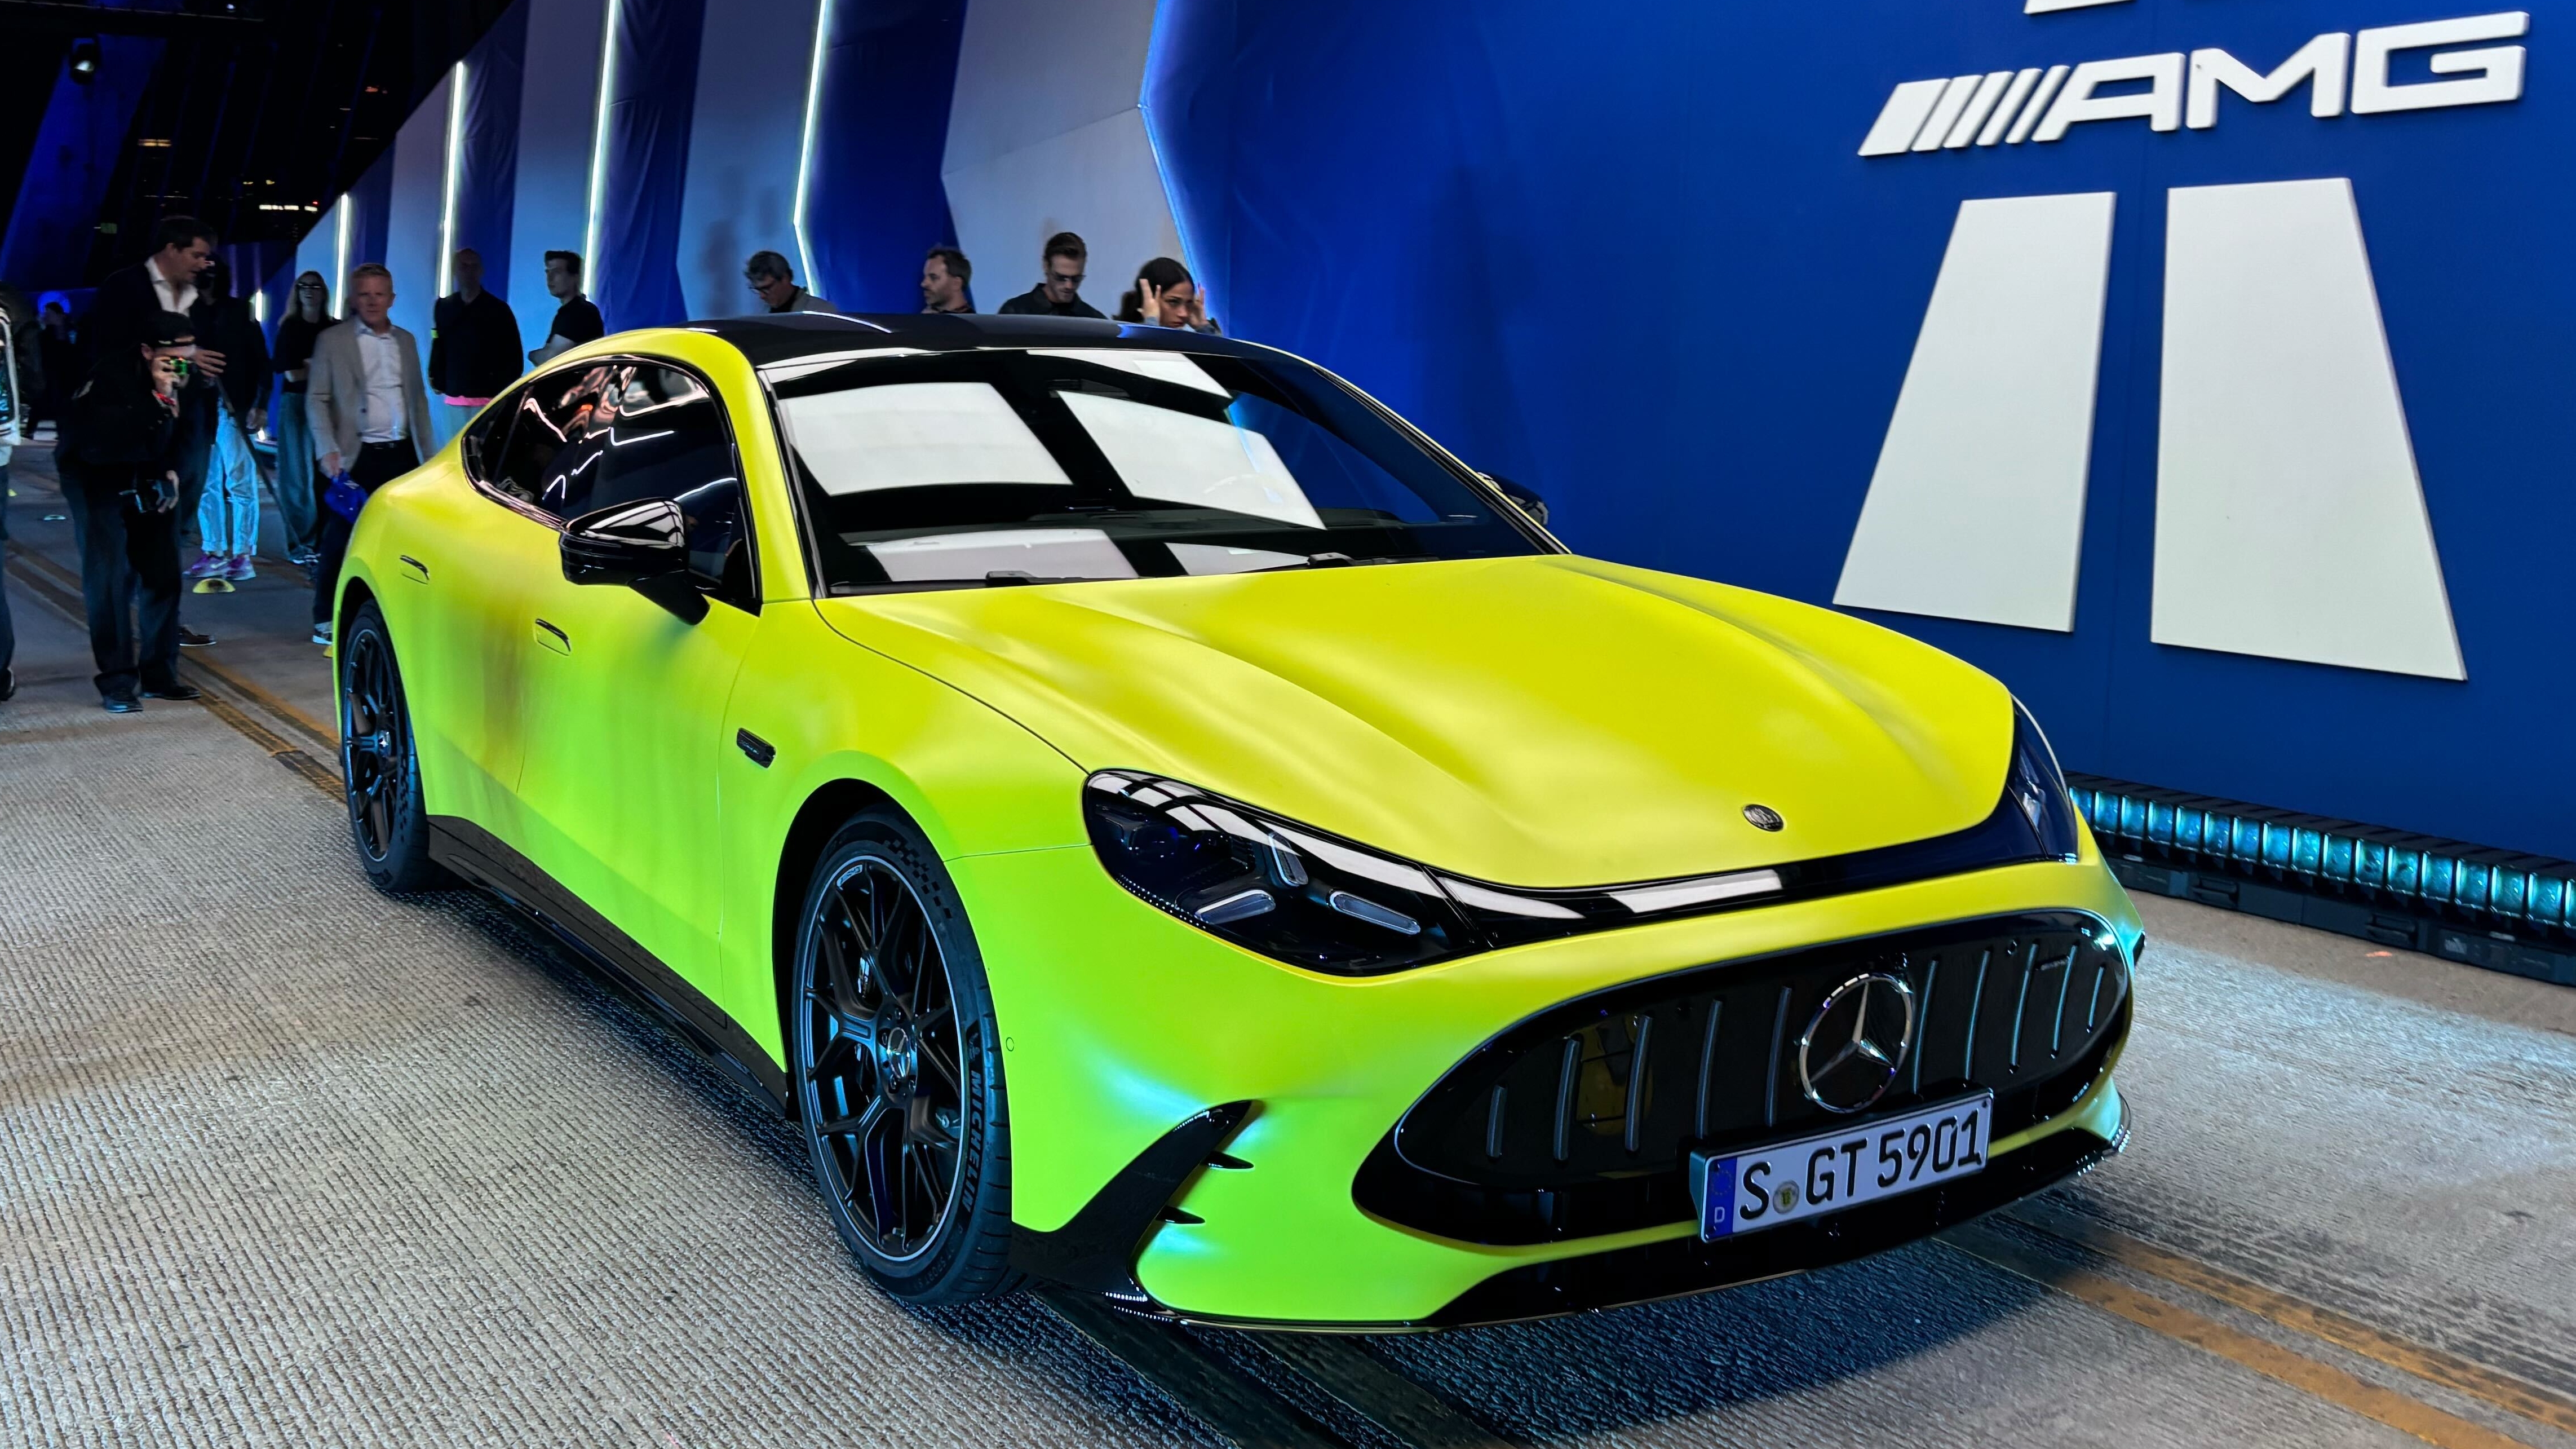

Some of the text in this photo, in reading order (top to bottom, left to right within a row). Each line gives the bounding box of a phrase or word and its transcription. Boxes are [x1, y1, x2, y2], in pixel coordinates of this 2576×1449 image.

[2030, 11, 2530, 143] AMG
[962, 1070, 982, 1213] MICHELIN
[1740, 1108, 1982, 1220] S GT 5901
[1714, 1206, 1725, 1223] D
